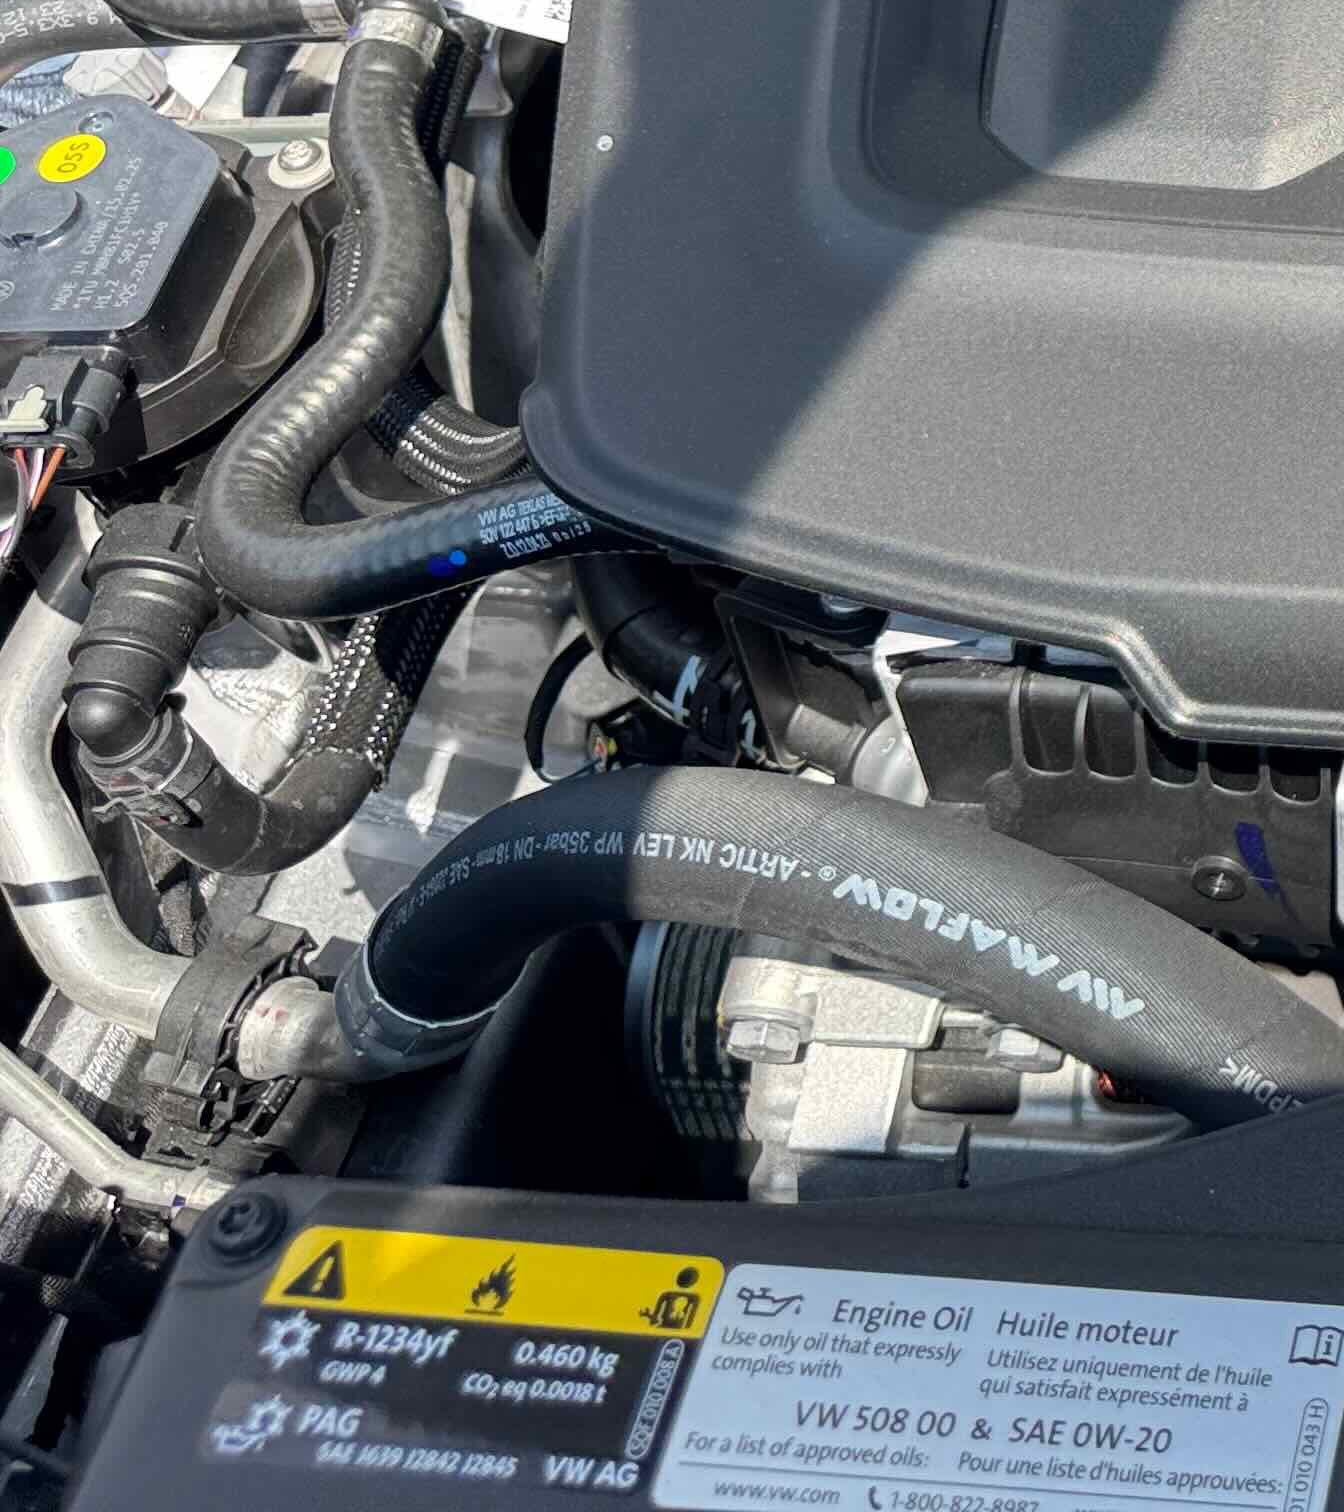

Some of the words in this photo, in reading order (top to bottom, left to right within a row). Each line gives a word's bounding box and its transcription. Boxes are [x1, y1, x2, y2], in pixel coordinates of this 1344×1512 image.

[478, 508, 498, 528] VW
[499, 503, 517, 520] AG
[514, 836, 535, 861] DN
[543, 831, 592, 856] 35bar
[594, 831, 624, 856] WP
[632, 832, 675, 860] LEV
[679, 837, 716, 865] NK
[719, 842, 801, 881] ARTIC
[832, 1299, 926, 1333] Engine
[934, 1306, 974, 1332] Oil
[997, 1310, 1069, 1339] Huile
[1076, 1319, 1179, 1347] moteur
[334, 1321, 459, 1367] R-1234yf
[513, 1341, 585, 1368] 0.460
[588, 1346, 620, 1378] kg
[721, 1327, 753, 1346] Use
[759, 1330, 801, 1354] only
[803, 1333, 828, 1352] oil
[831, 1335, 869, 1356] that
[873, 1340, 961, 1366] expressly
[319, 1360, 370, 1383] GWP
[501, 1380, 527, 1402] eq
[529, 1378, 592, 1402] 0.0018
[597, 1384, 608, 1403] t
[711, 1353, 794, 1377] complies
[800, 1359, 843, 1378] with
[987, 1349, 1057, 1372] Utilisez
[1063, 1356, 1181, 1381] uniquement
[1186, 1363, 1210, 1384] de
[1214, 1365, 1273, 1387] l'huile
[978, 1377, 1010, 1398] qui
[1015, 1377, 1092, 1401] satisfait
[1096, 1386, 1233, 1412] expressément
[1237, 1393, 1249, 1411] à
[296, 1404, 363, 1438] PAG
[796, 1399, 850, 1429] VW
[853, 1406, 909, 1434] 508
[917, 1410, 957, 1437] 00
[970, 1417, 993, 1440] &
[1008, 1417, 1067, 1445] SAE
[1073, 1422, 1173, 1453] 0W-20
[684, 1431, 717, 1451] For
[718, 1437, 732, 1453] a
[735, 1434, 764, 1456] list
[769, 1437, 796, 1458] of
[791, 1443, 887, 1466] approved
[889, 1447, 930, 1467] oils:
[545, 1454, 595, 1485] VW
[594, 1461, 641, 1488] AG
[957, 1451, 1003, 1473] Pour
[1006, 1458, 1043, 1476] une
[1046, 1458, 1086, 1480] liste
[1089, 1460, 1162, 1486] d'huiles
[1166, 1469, 1283, 1495] approuvées:
[714, 1481, 841, 1504] www.vw.com
